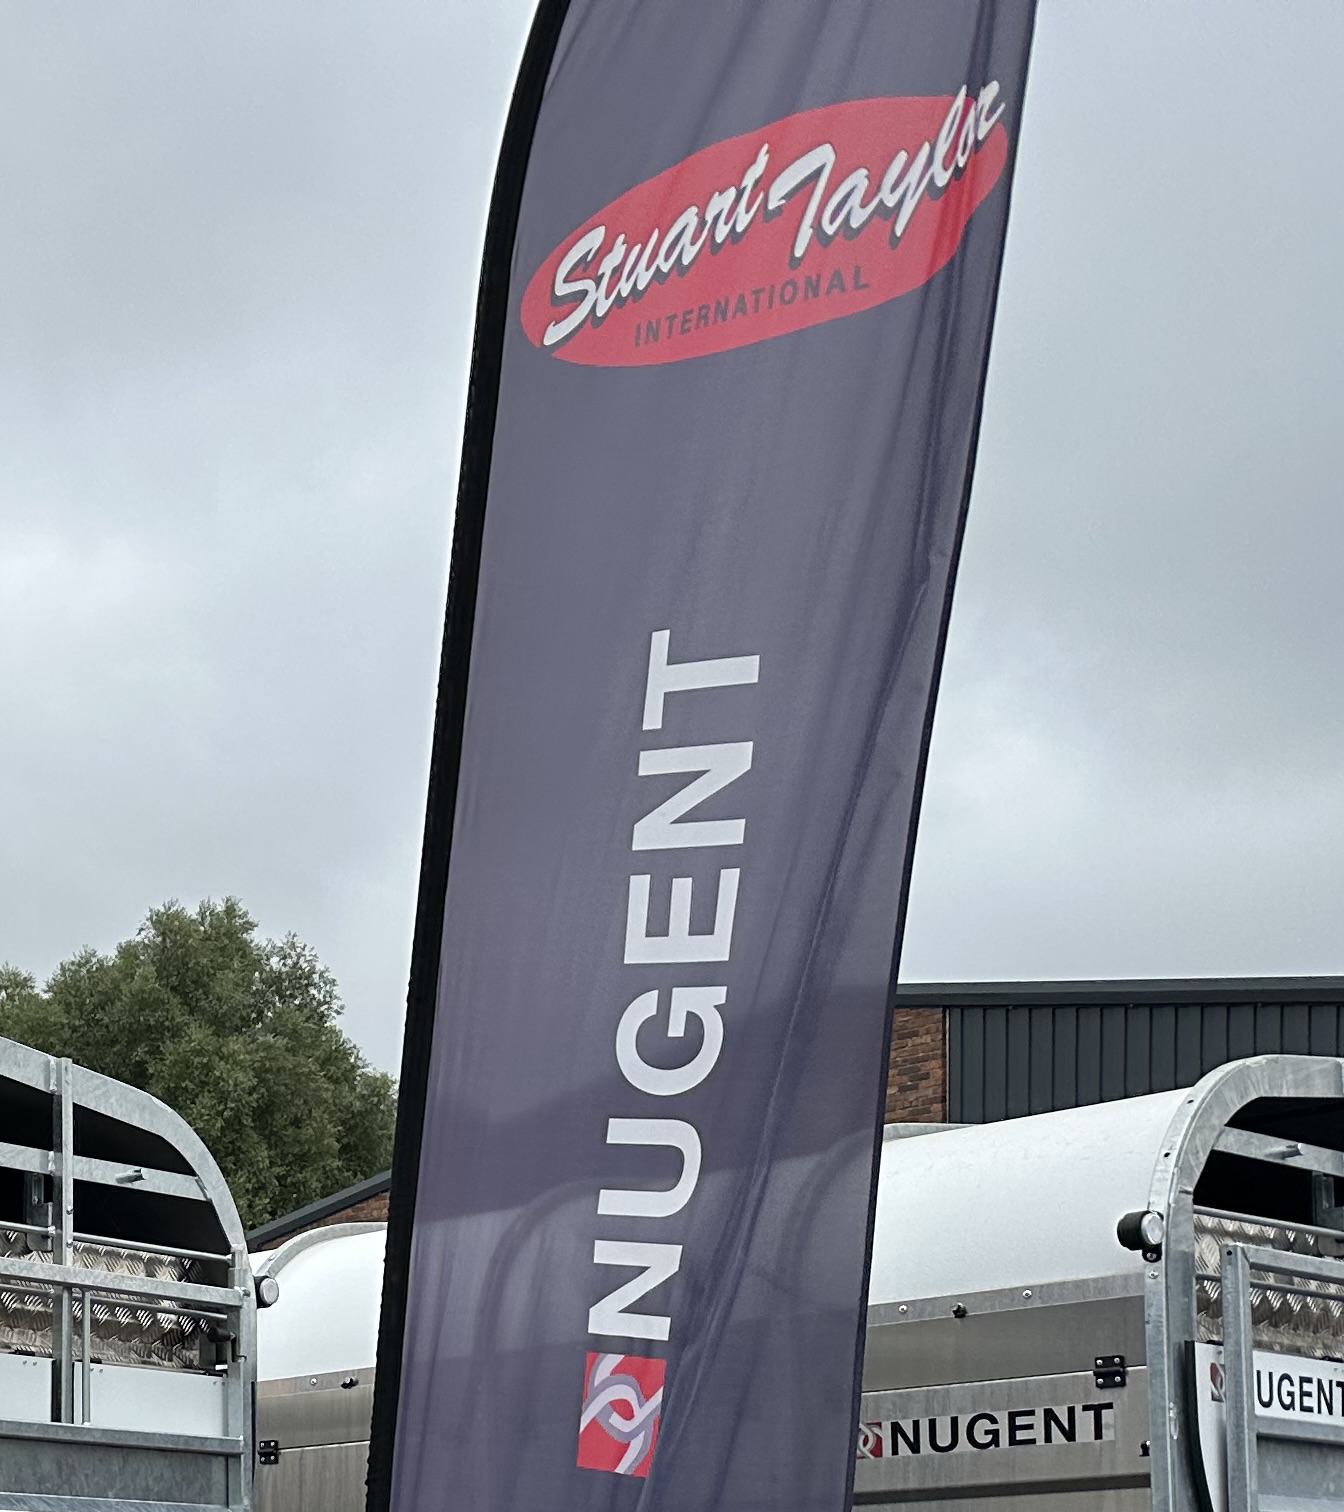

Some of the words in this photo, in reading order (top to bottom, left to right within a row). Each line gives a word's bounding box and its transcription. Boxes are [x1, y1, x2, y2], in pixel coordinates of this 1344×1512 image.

[543, 142, 770, 346] Stuart
[767, 80, 1006, 262] Taylor
[634, 264, 870, 347] INTERNATIONAL
[587, 629, 760, 1341] NUGENT
[890, 1402, 1113, 1456] NUGENT
